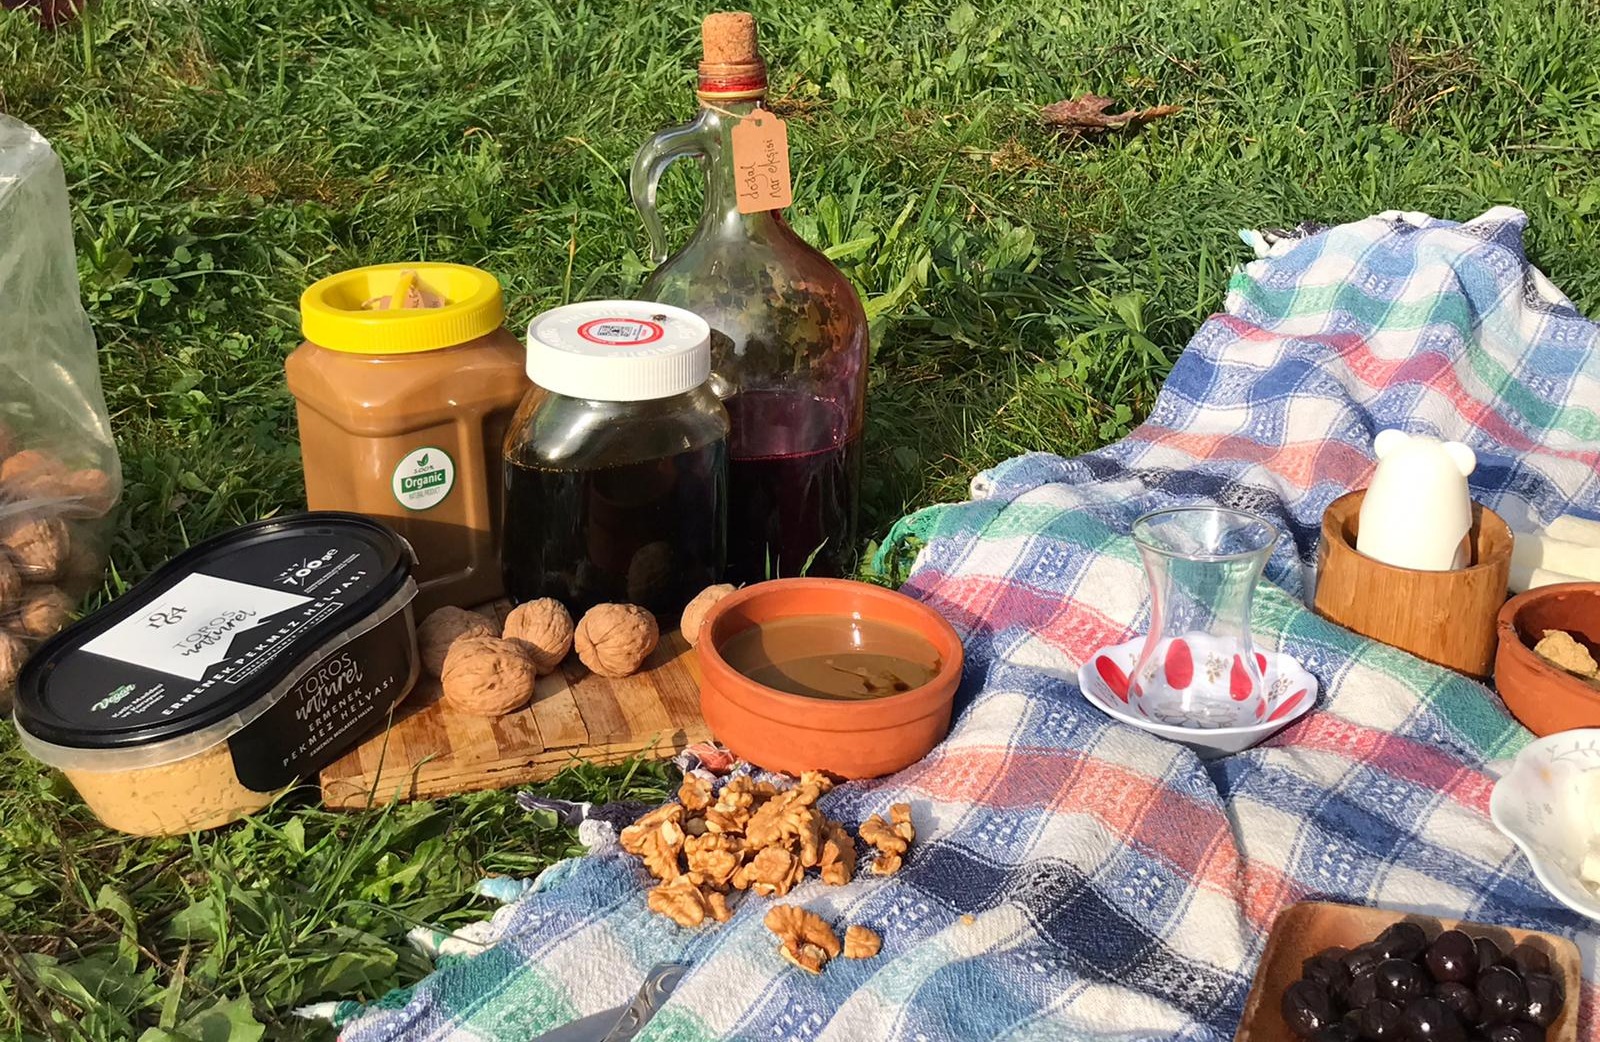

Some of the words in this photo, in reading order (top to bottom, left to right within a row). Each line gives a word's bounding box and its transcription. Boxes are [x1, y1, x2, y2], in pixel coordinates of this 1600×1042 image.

[405, 472, 443, 488] Organic
[162, 666, 235, 716] ERMENEK
[235, 621, 300, 665] PEKMEZ
[303, 571, 367, 616] HELVASI
[172, 611, 236, 649] TOROS
[181, 609, 257, 656] naturel
[91, 684, 136, 712] Vegan
[294, 652, 352, 700] TOROS
[295, 661, 363, 720] naturel
[282, 721, 334, 767] PEKMEZ
[340, 676, 394, 720] HELVASI
[308, 686, 362, 732] ERMENEK
